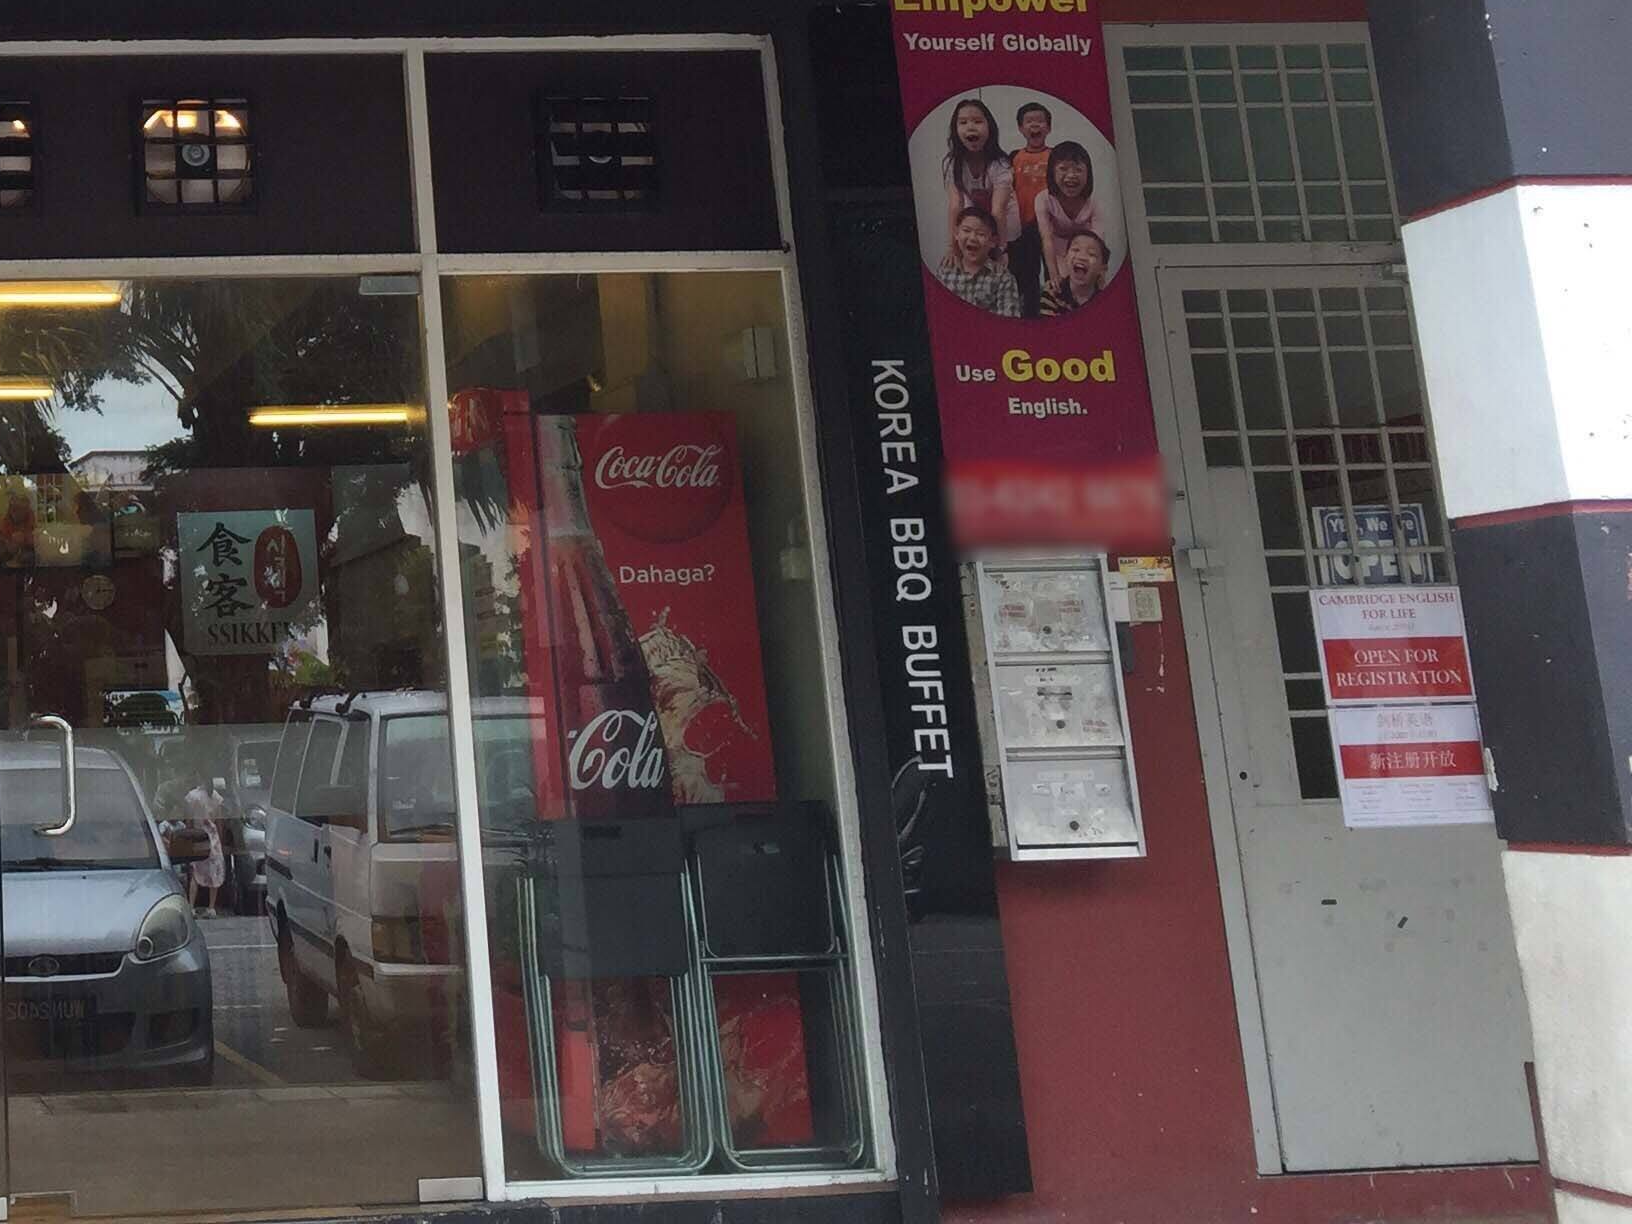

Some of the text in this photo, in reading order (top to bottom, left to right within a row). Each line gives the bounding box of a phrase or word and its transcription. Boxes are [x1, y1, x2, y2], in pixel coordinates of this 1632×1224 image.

[903, 32, 1092, 57] Yourself Globally
[955, 349, 1117, 383] Use Good
[1007, 396, 1089, 419] English.
[619, 564, 716, 587] Dahaga?
[871, 359, 954, 778] KOREA BBQ BUFFET
[1318, 591, 1455, 606] CAMBRIDGE ENGLISH
[1362, 608, 1416, 620] FOR LIFE
[1353, 649, 1440, 665] OPEN FOR
[1336, 669, 1463, 687] REGISTRATION
[569, 708, 665, 790] Cola
